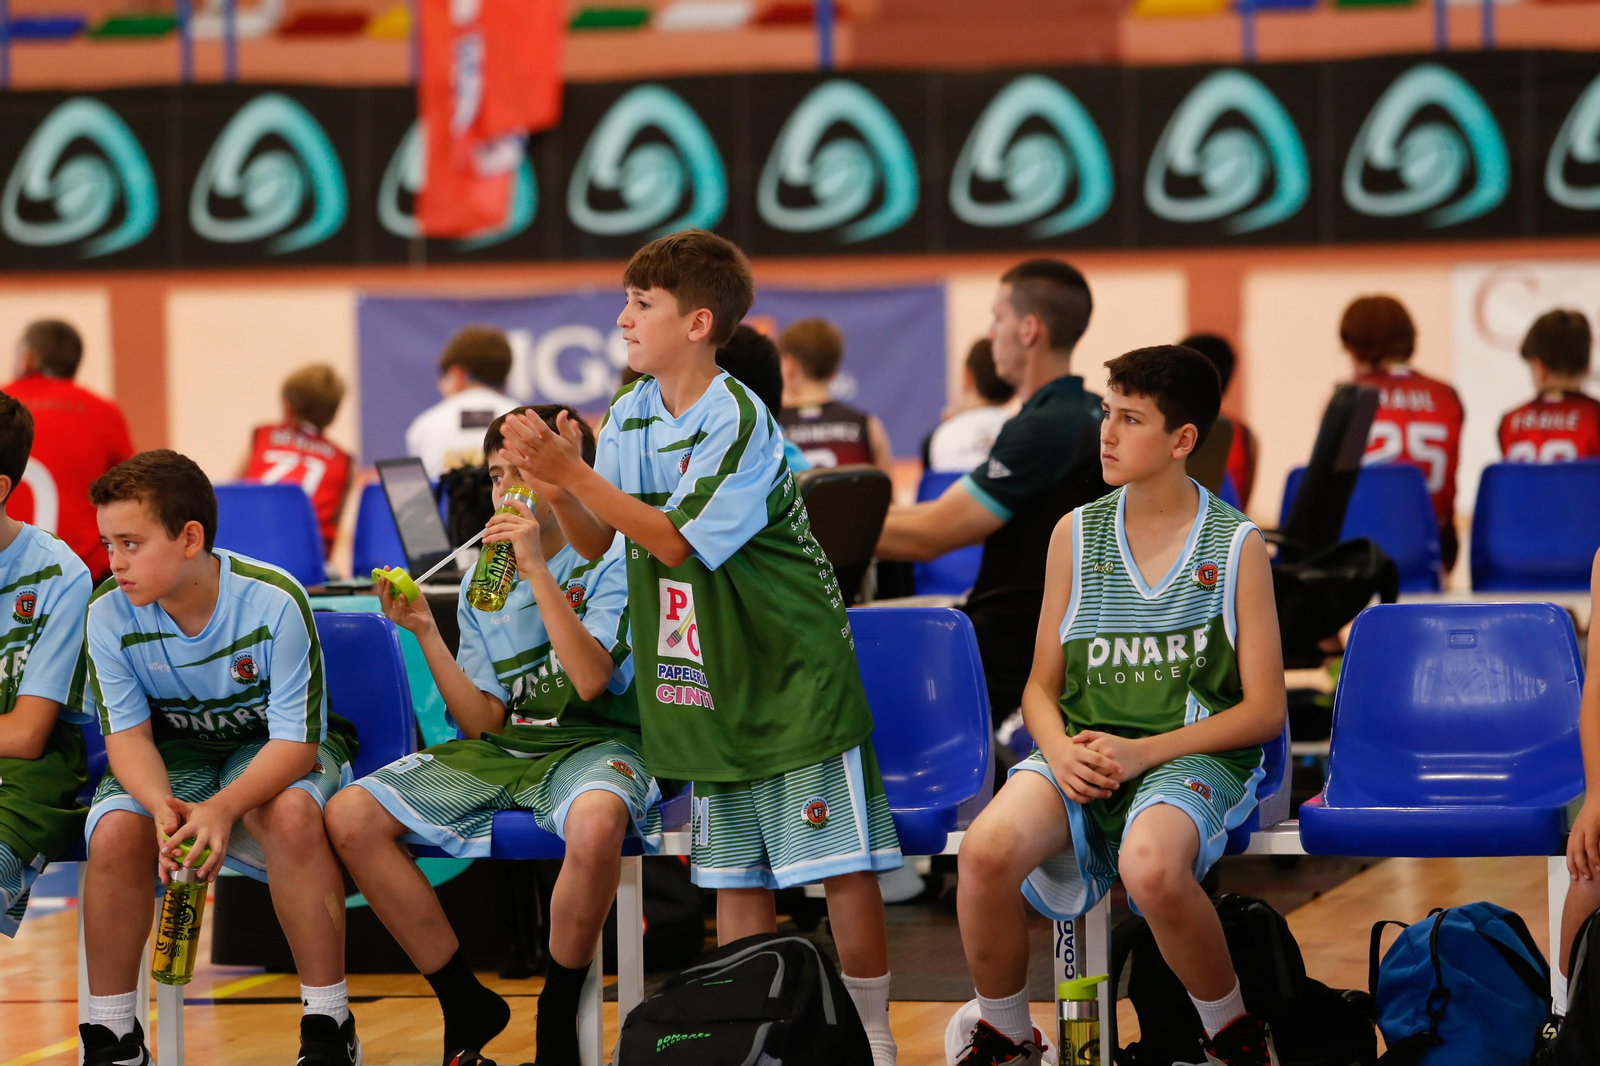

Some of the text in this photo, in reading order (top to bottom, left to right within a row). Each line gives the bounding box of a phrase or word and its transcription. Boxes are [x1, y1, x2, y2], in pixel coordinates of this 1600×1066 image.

[1361, 420, 1448, 495] 25
[666, 587, 688, 621] P
[656, 683, 715, 711] CINTI
